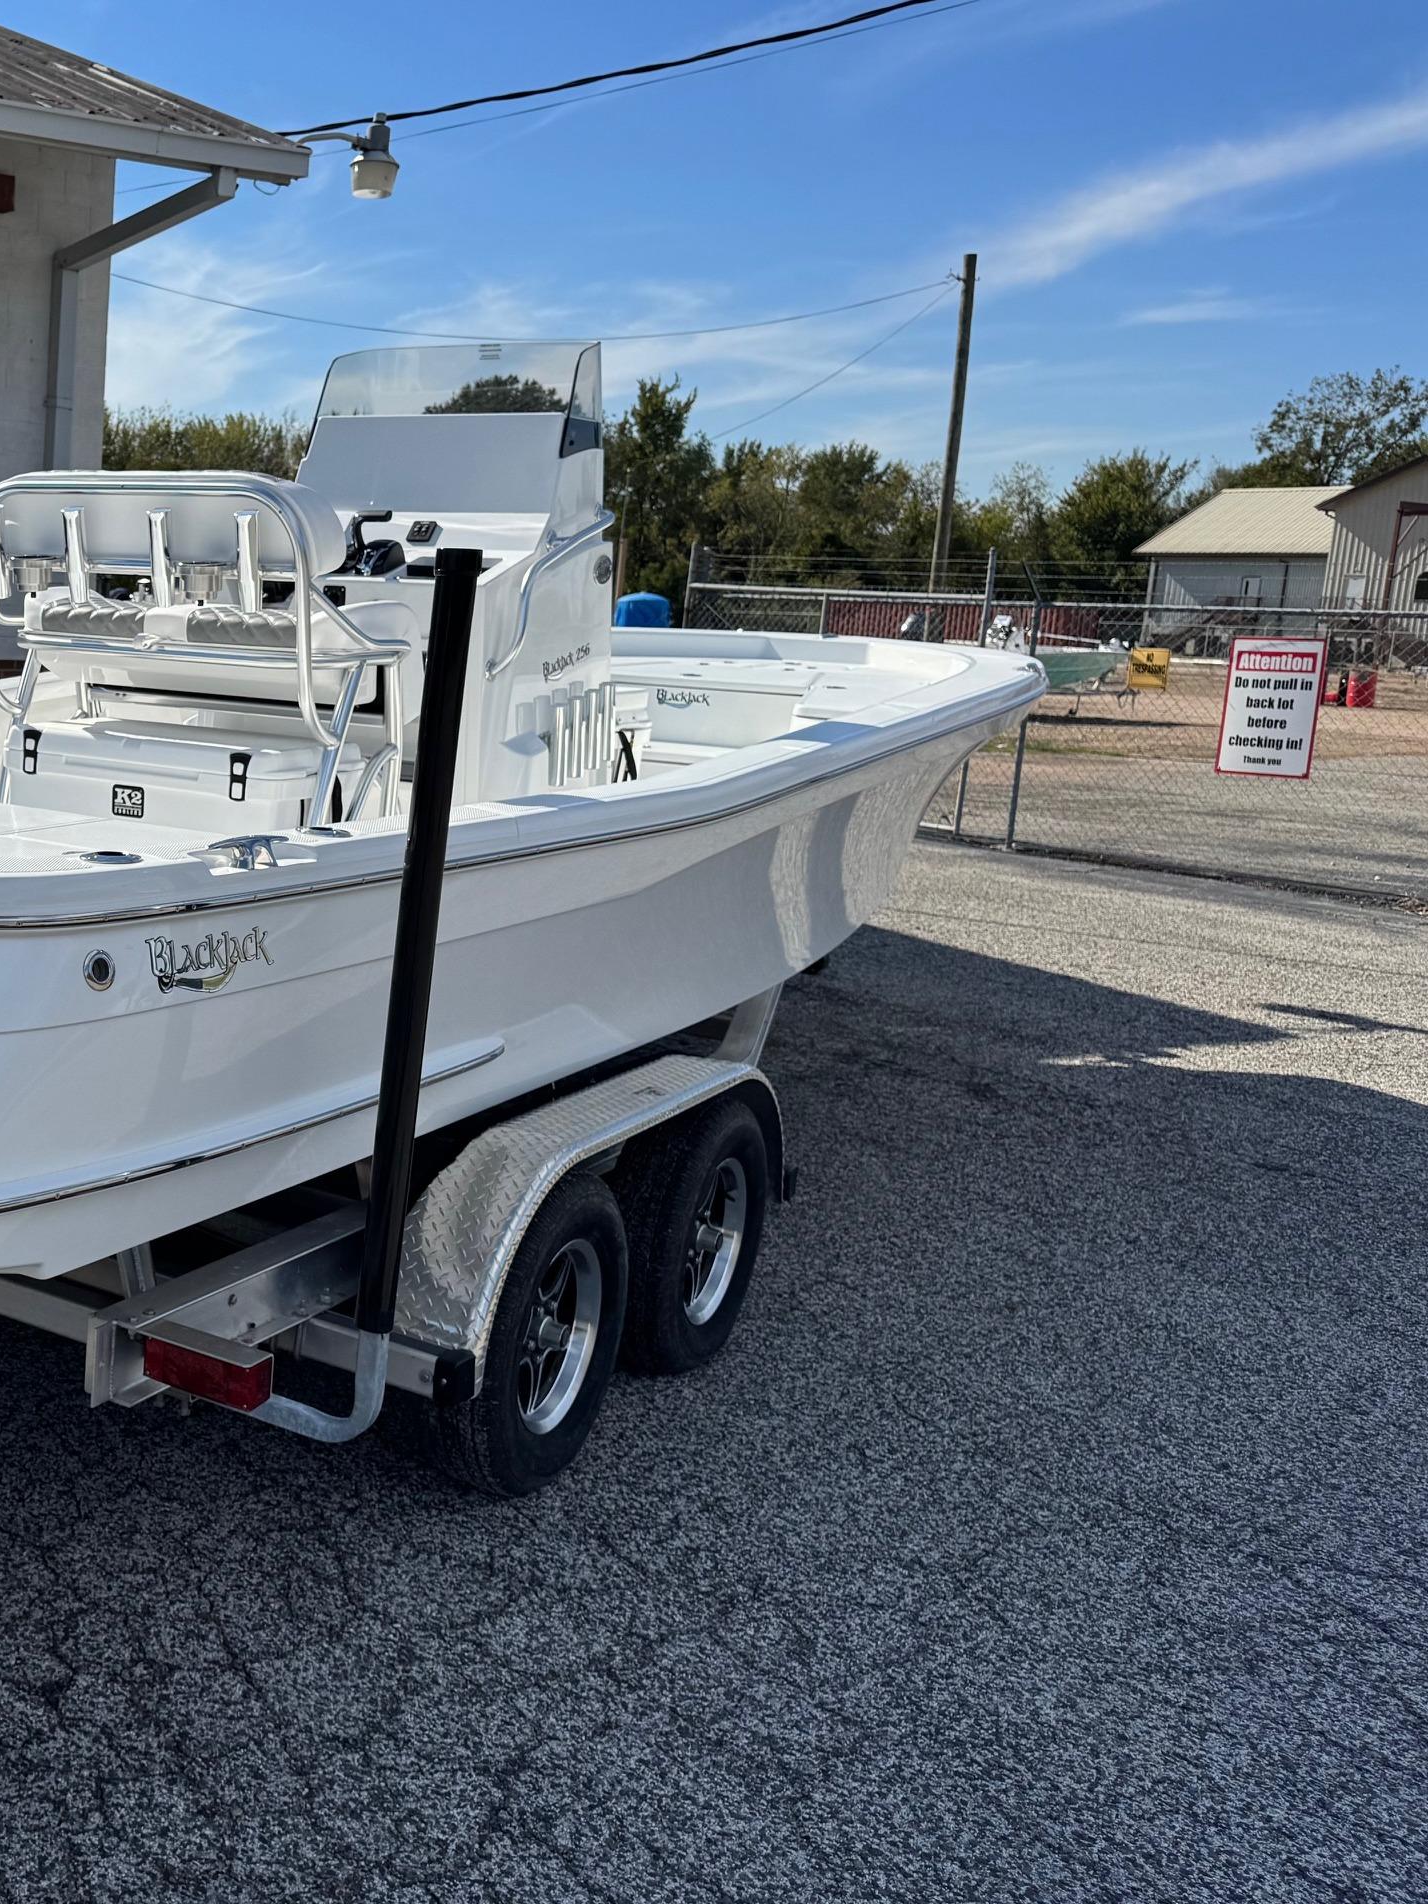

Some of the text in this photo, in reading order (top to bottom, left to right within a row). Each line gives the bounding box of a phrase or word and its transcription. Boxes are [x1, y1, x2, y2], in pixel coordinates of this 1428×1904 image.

[575, 642, 590, 661] 256
[1239, 653, 1314, 671] Attention
[1235, 676, 1313, 691] Do not pull in
[1246, 696, 1294, 710] back lot
[1247, 716, 1287, 729] before
[1228, 735, 1303, 751] checking in!
[1243, 755, 1282, 766] Thank you
[114, 787, 142, 806] K2
